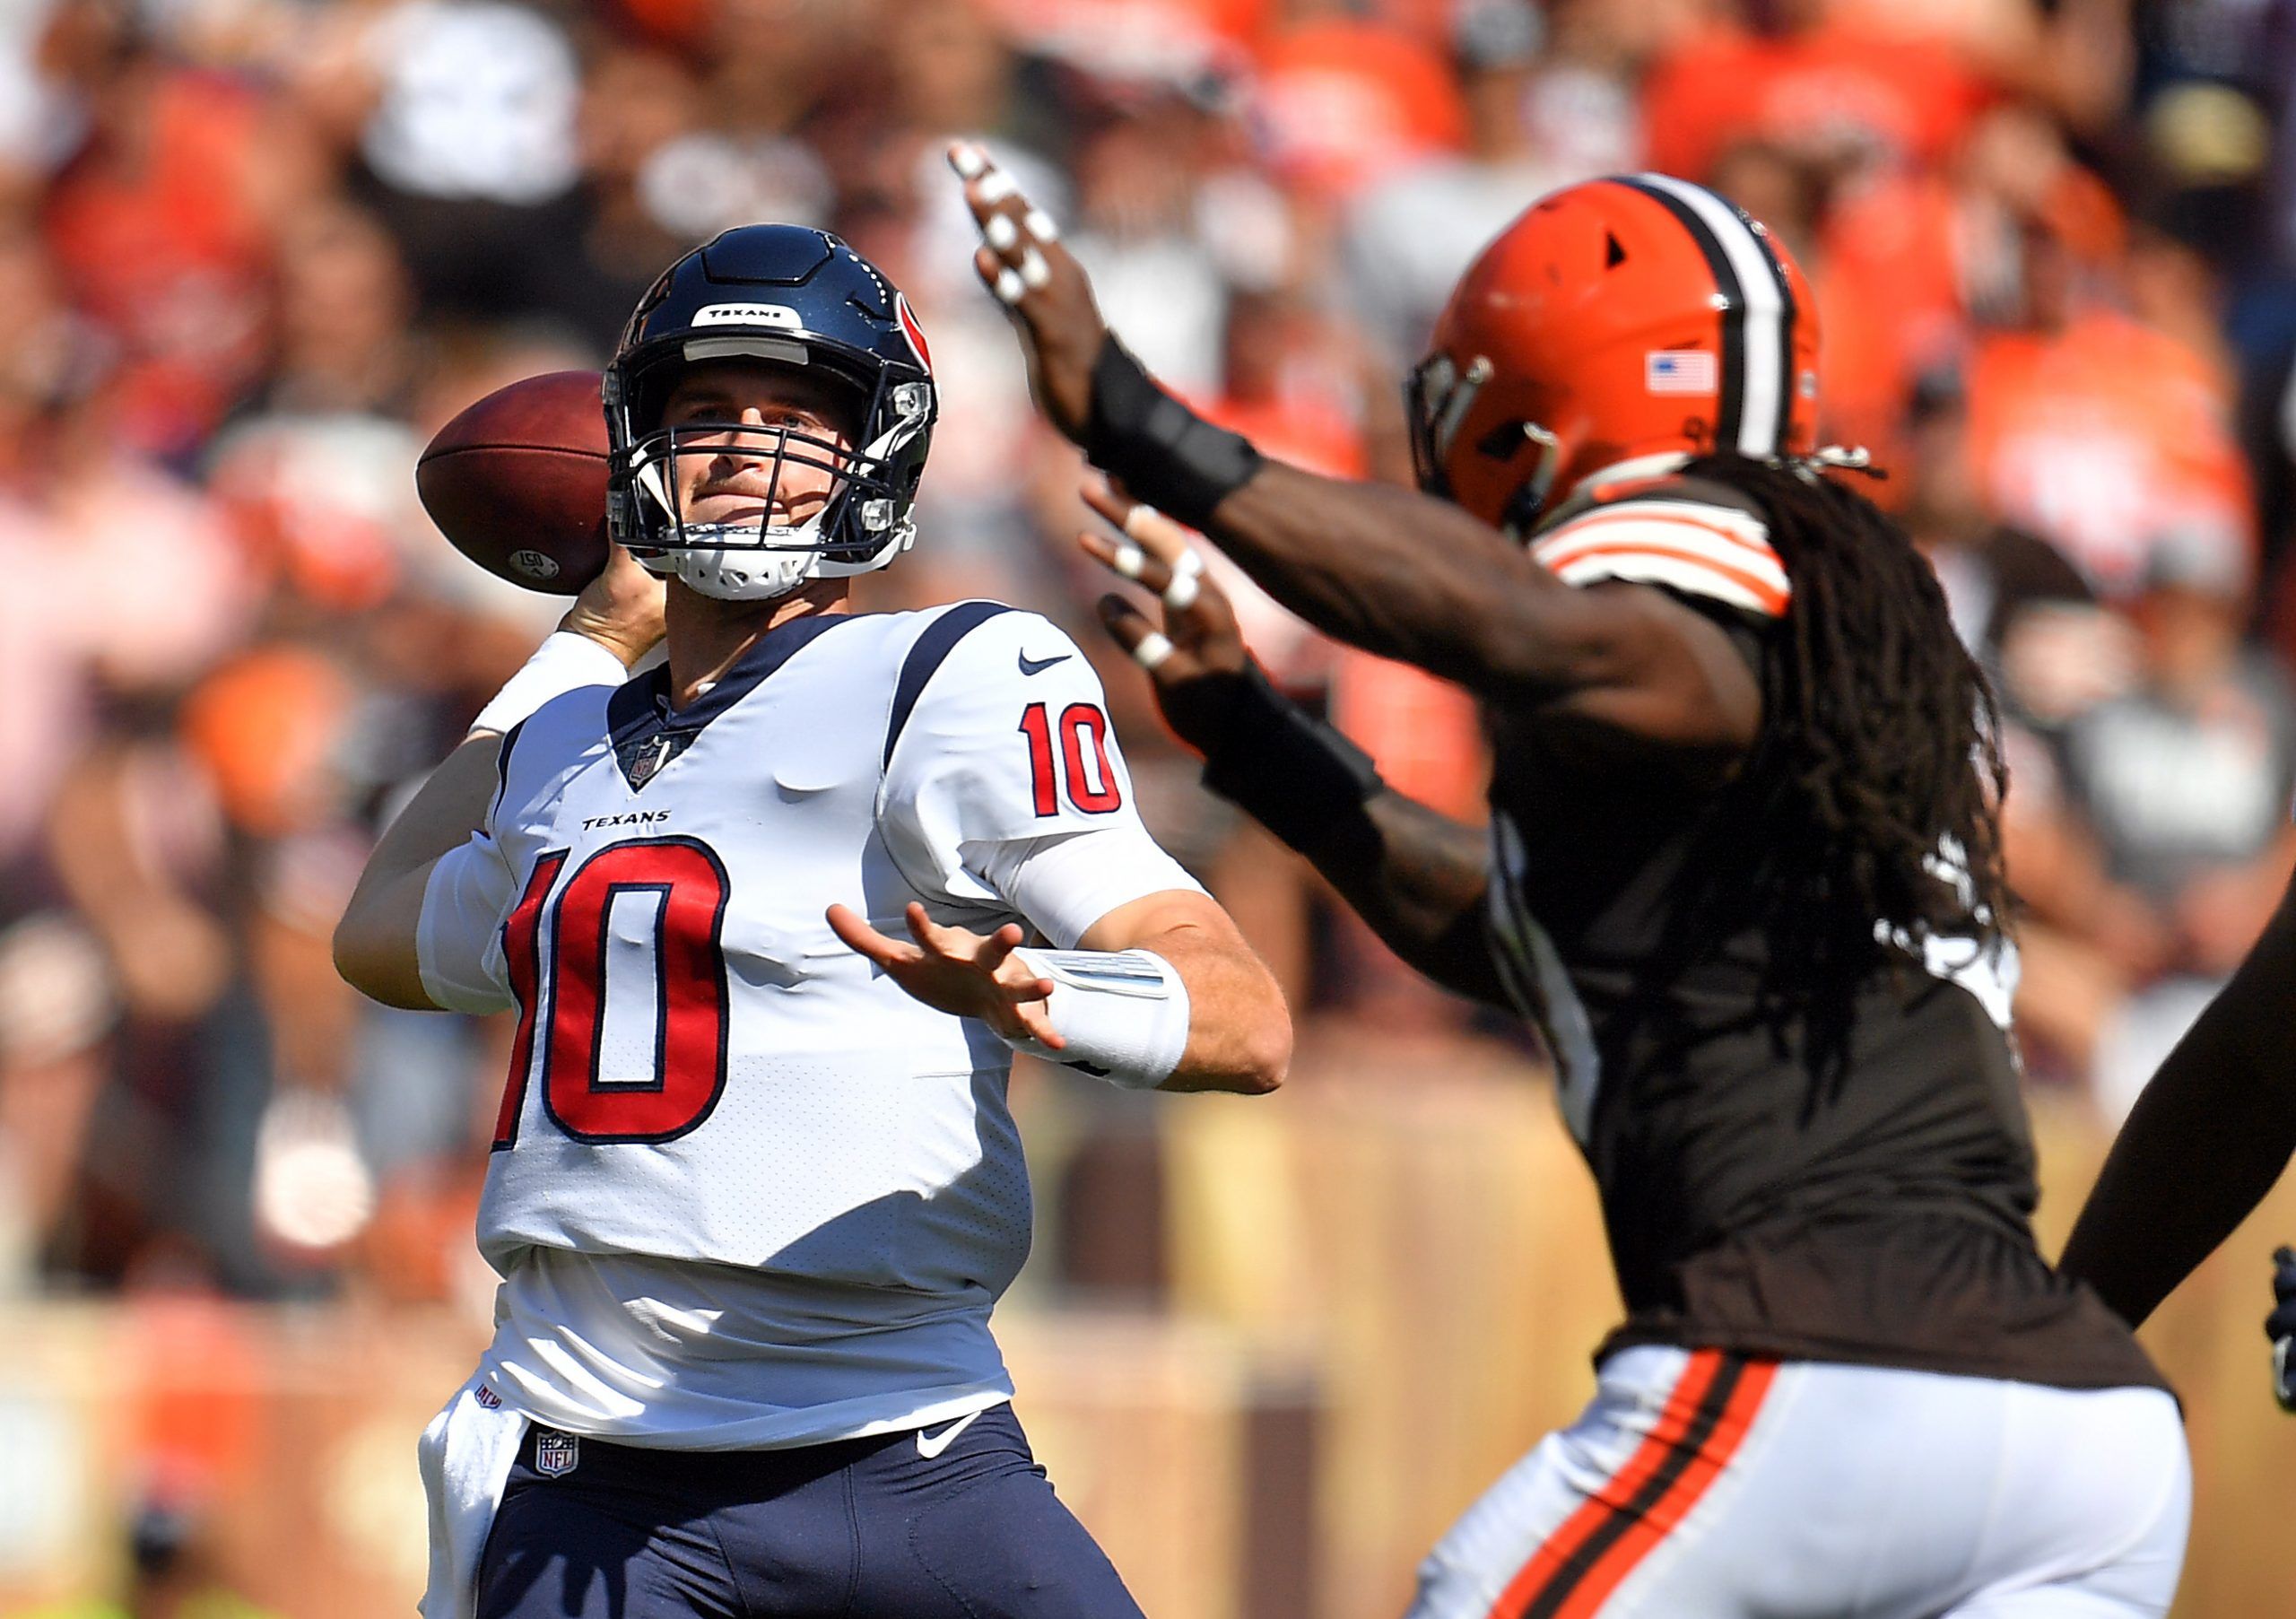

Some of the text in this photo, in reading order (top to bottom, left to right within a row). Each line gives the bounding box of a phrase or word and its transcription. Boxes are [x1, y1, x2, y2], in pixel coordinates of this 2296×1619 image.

[709, 309, 780, 318] TEXANS
[1018, 701, 1122, 818] 10
[581, 809, 672, 831] TEXANS
[491, 835, 730, 1153] 10
[544, 1450, 571, 1468] NFL
